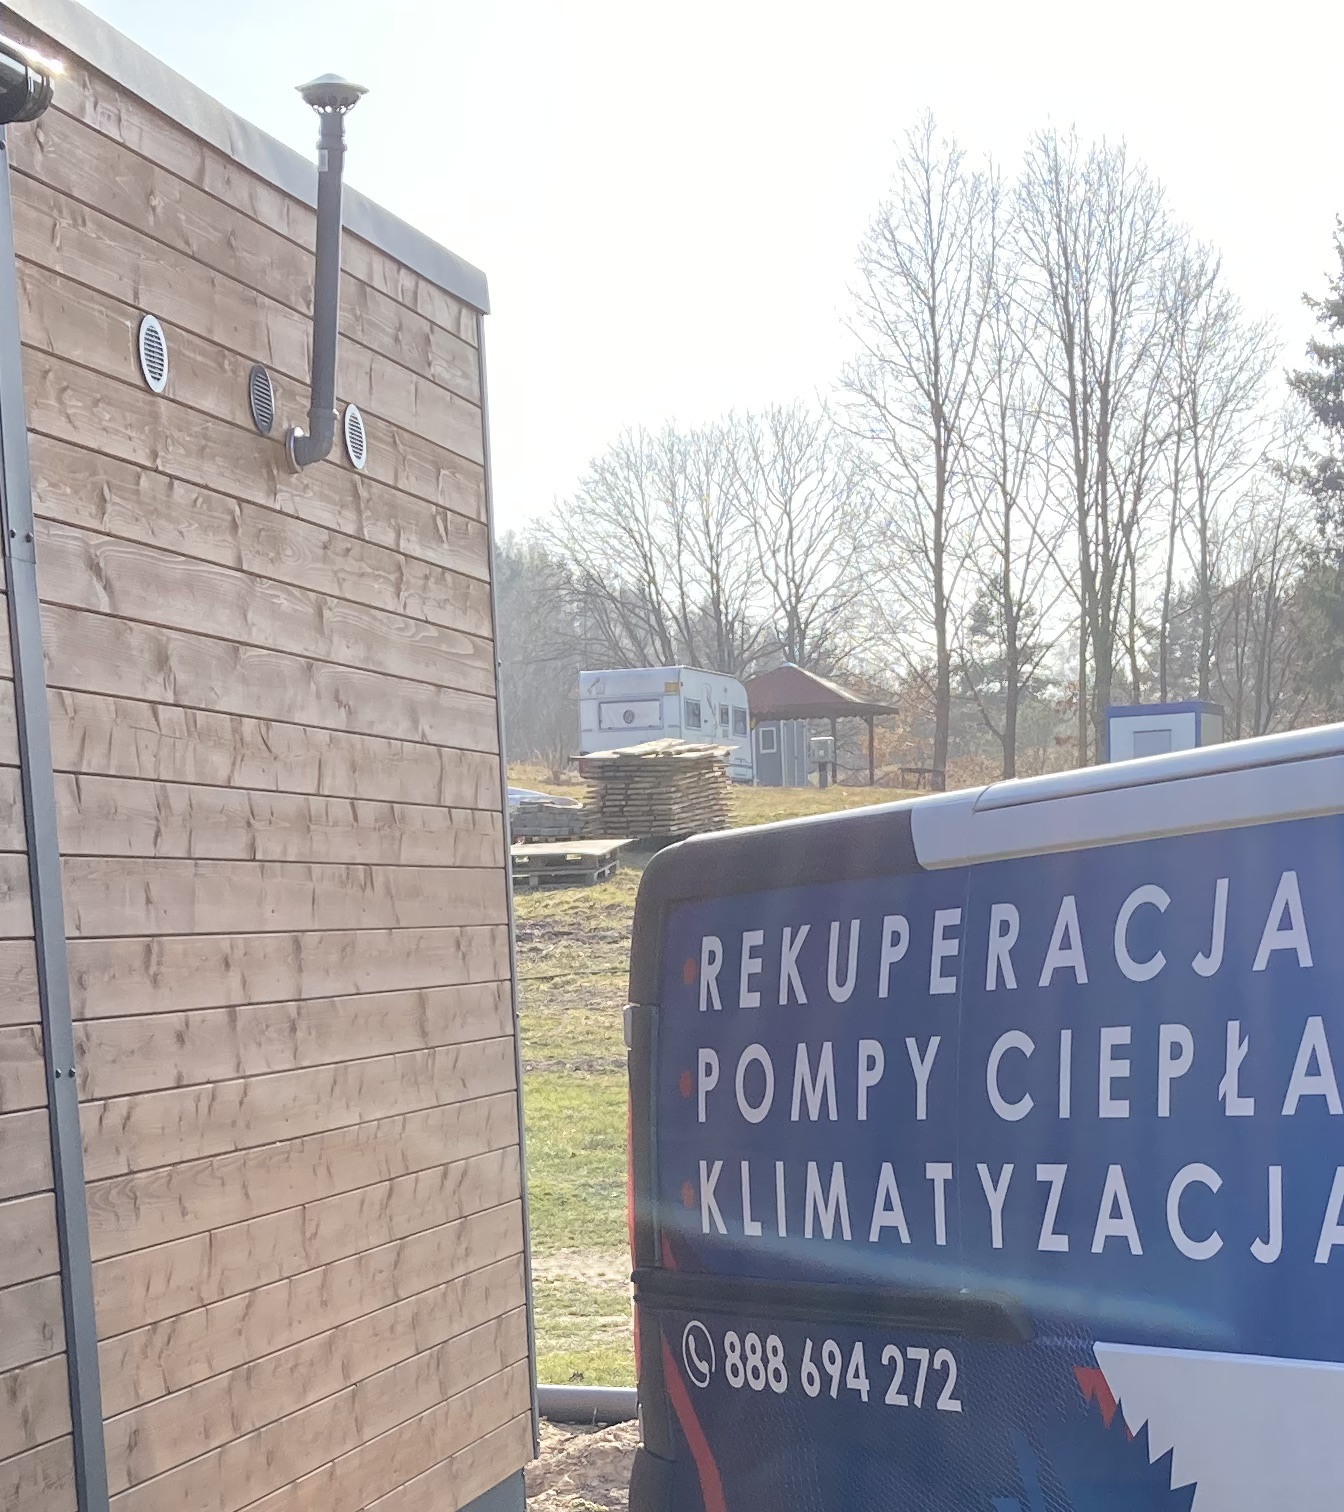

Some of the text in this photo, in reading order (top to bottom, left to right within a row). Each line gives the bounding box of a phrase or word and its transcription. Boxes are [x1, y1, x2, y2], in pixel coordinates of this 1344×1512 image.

[698, 870, 1314, 1012] REKUPERACJA
[697, 1015, 1344, 1123] POMPY CIEPŁA
[723, 1330, 964, 1412] 888 694 272
